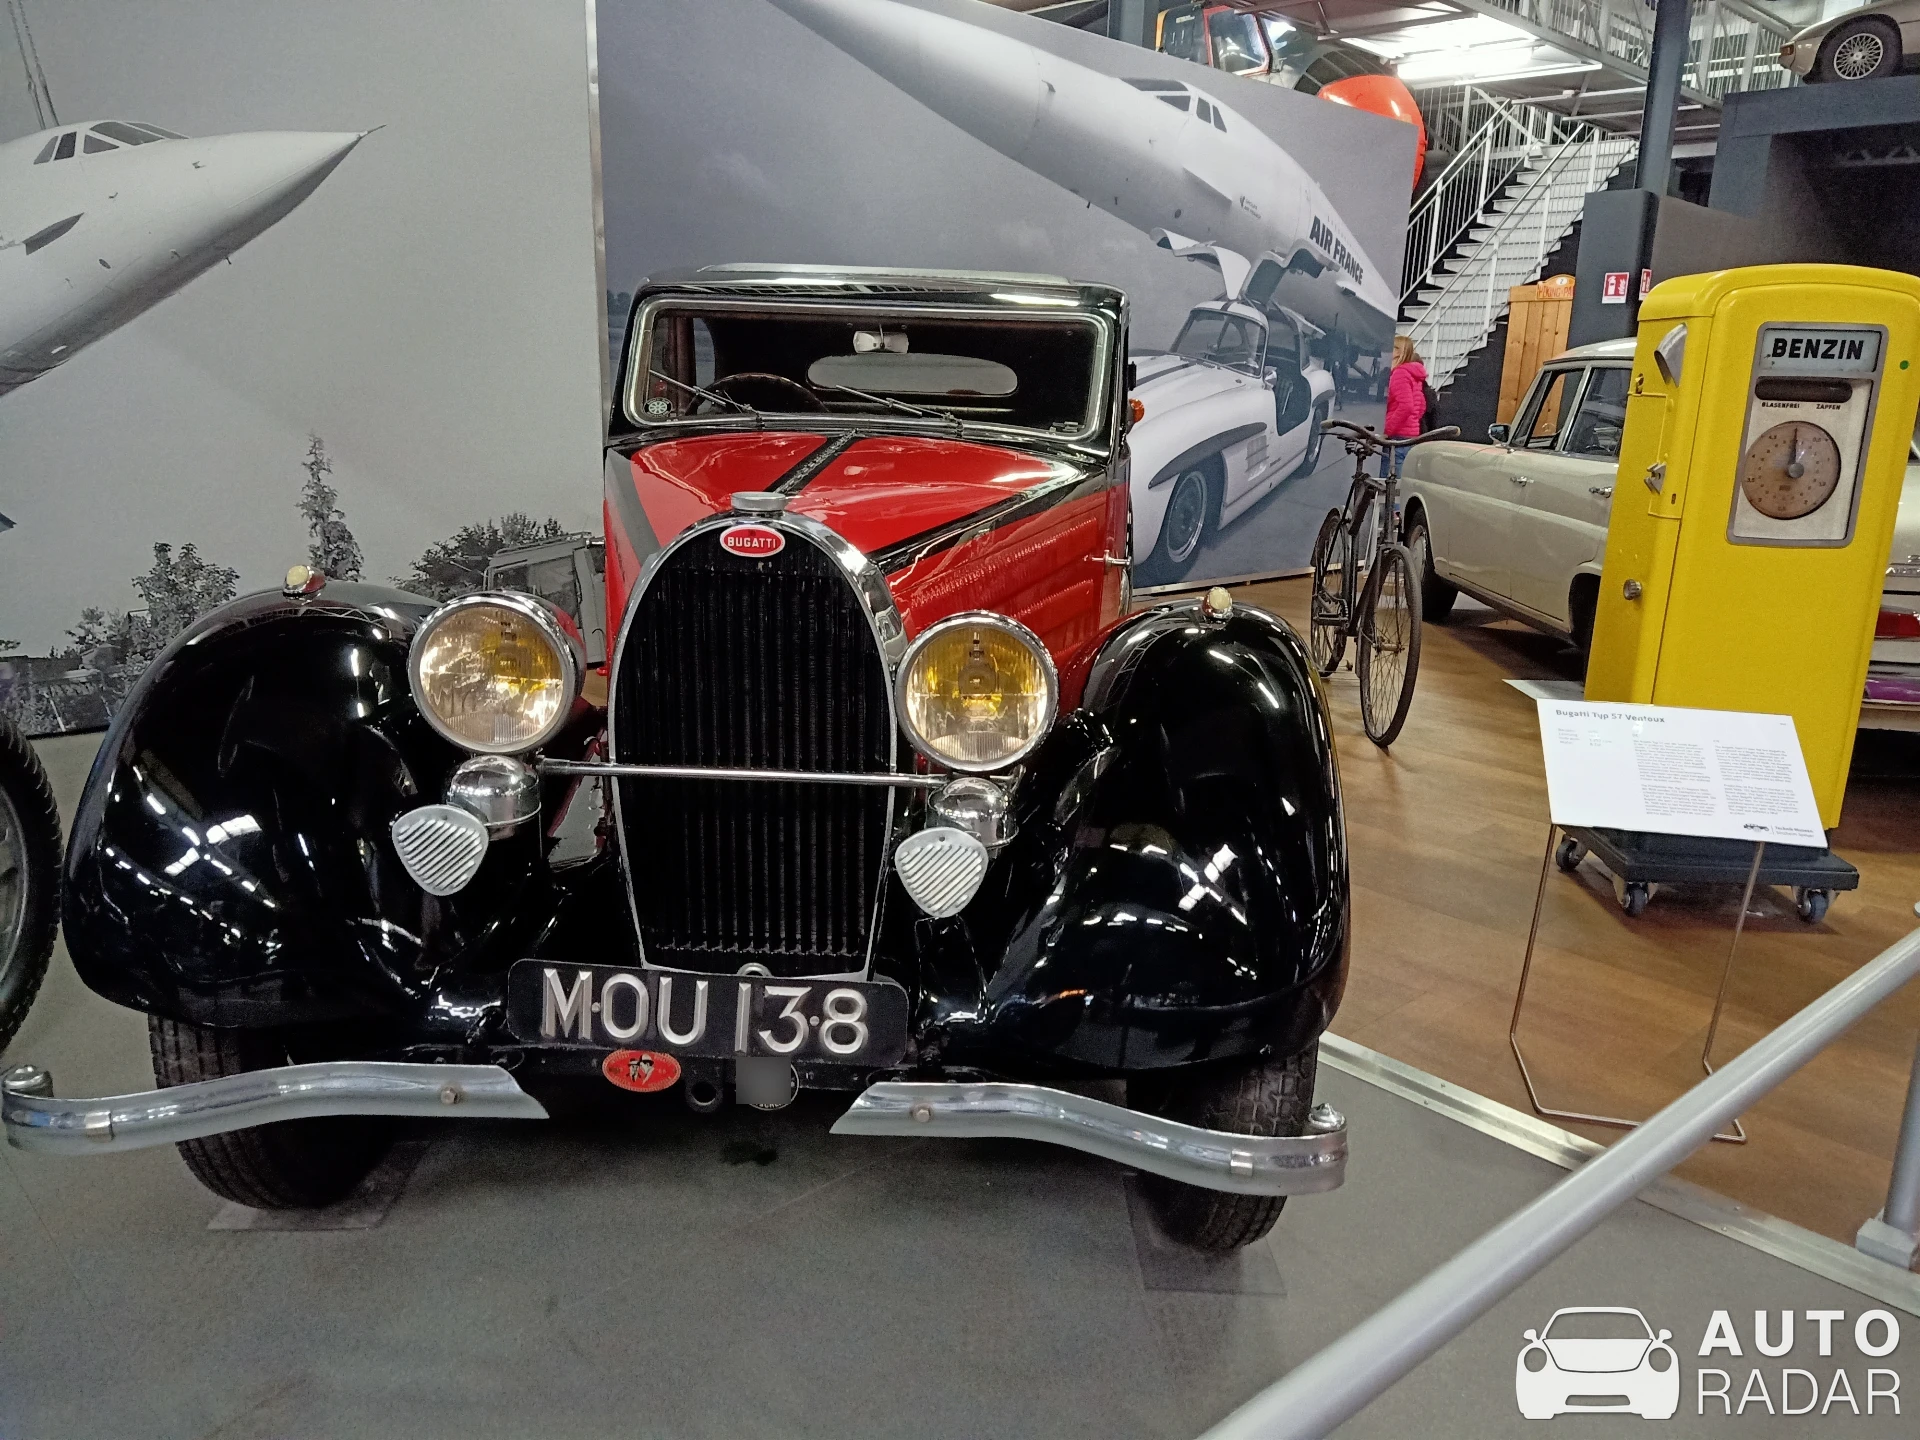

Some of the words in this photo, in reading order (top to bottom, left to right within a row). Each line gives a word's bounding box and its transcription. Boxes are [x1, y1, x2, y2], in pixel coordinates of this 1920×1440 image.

[1309, 215, 1333, 255] AIR
[1333, 237, 1364, 285] FRANCE
[1772, 338, 1864, 360] BENZIN
[1761, 401, 1800, 409] BLASENFREI
[727, 536, 776, 549] BUGATTI
[1555, 709, 1590, 718] Bugatti
[1592, 711, 1609, 720] Typ
[1625, 714, 1665, 723] Ventoux
[734, 982, 869, 1056] 138
